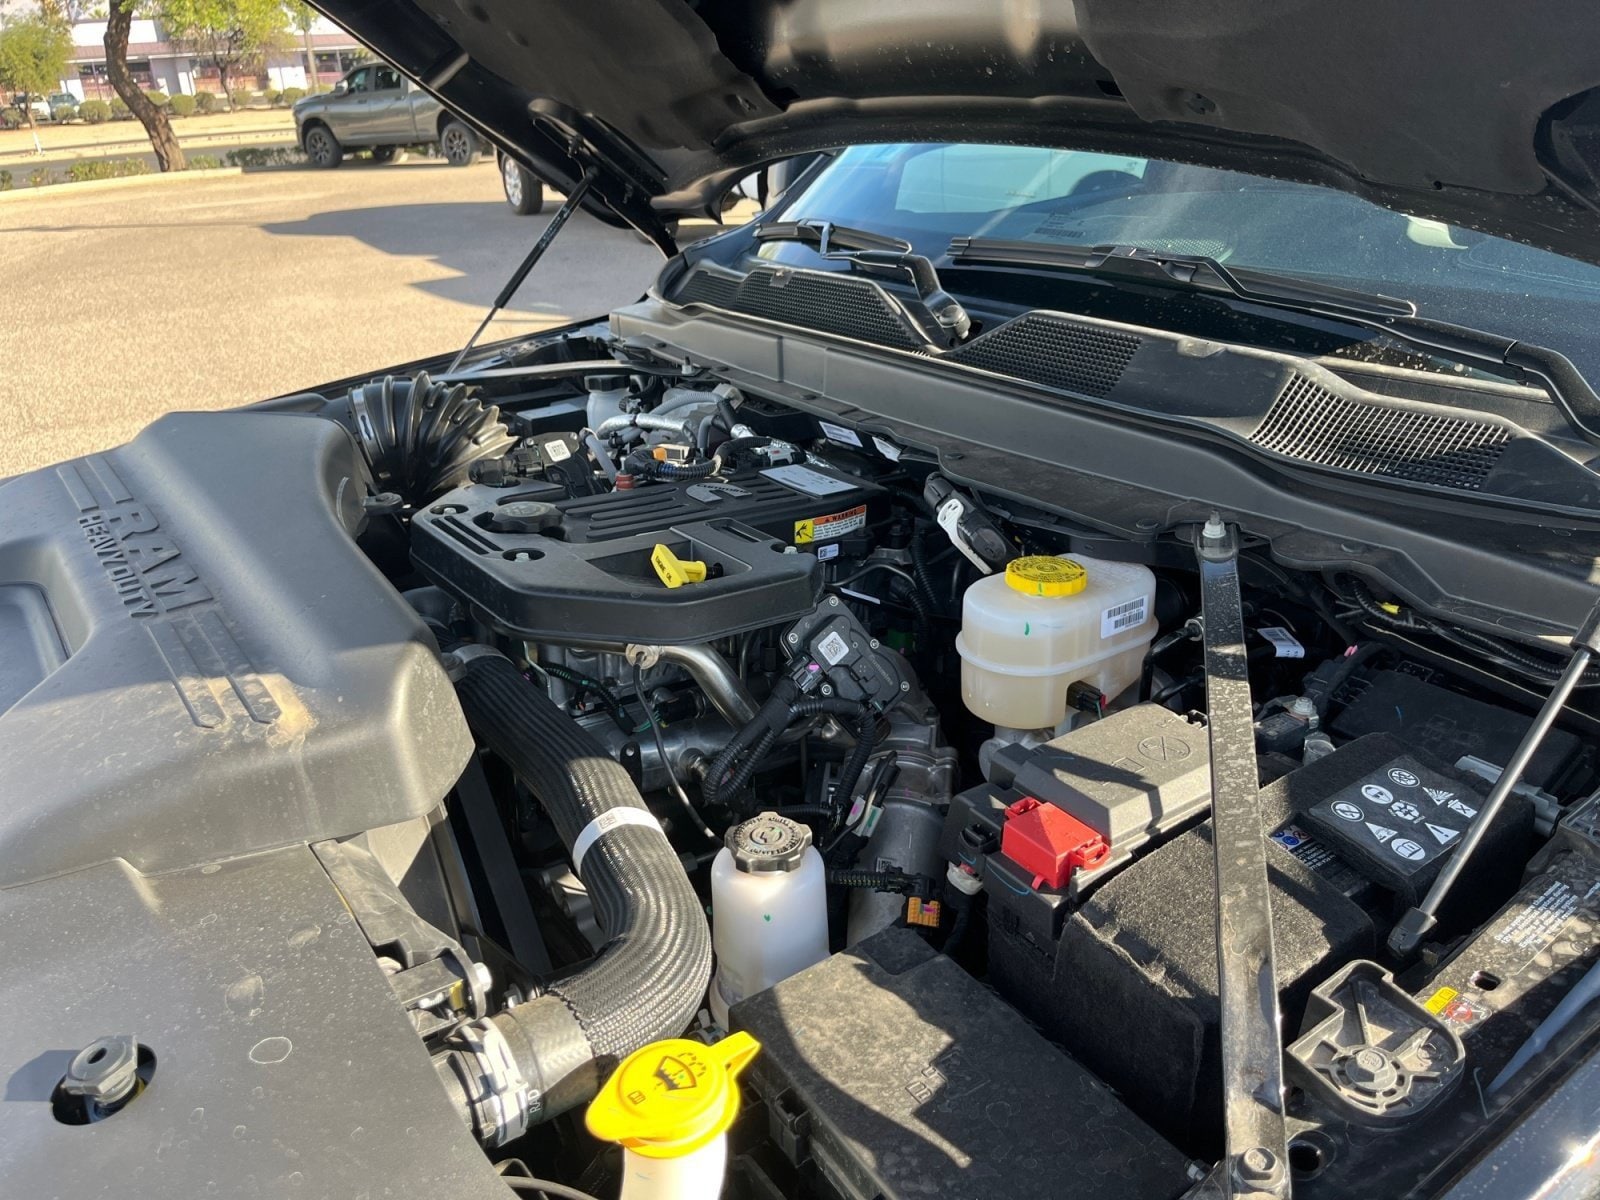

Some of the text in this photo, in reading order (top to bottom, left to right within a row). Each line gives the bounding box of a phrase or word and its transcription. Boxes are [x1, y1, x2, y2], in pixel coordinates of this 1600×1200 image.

[832, 508, 857, 521] WARNING
[104, 503, 214, 612] RAM
[528, 1089, 541, 1113] RAD
